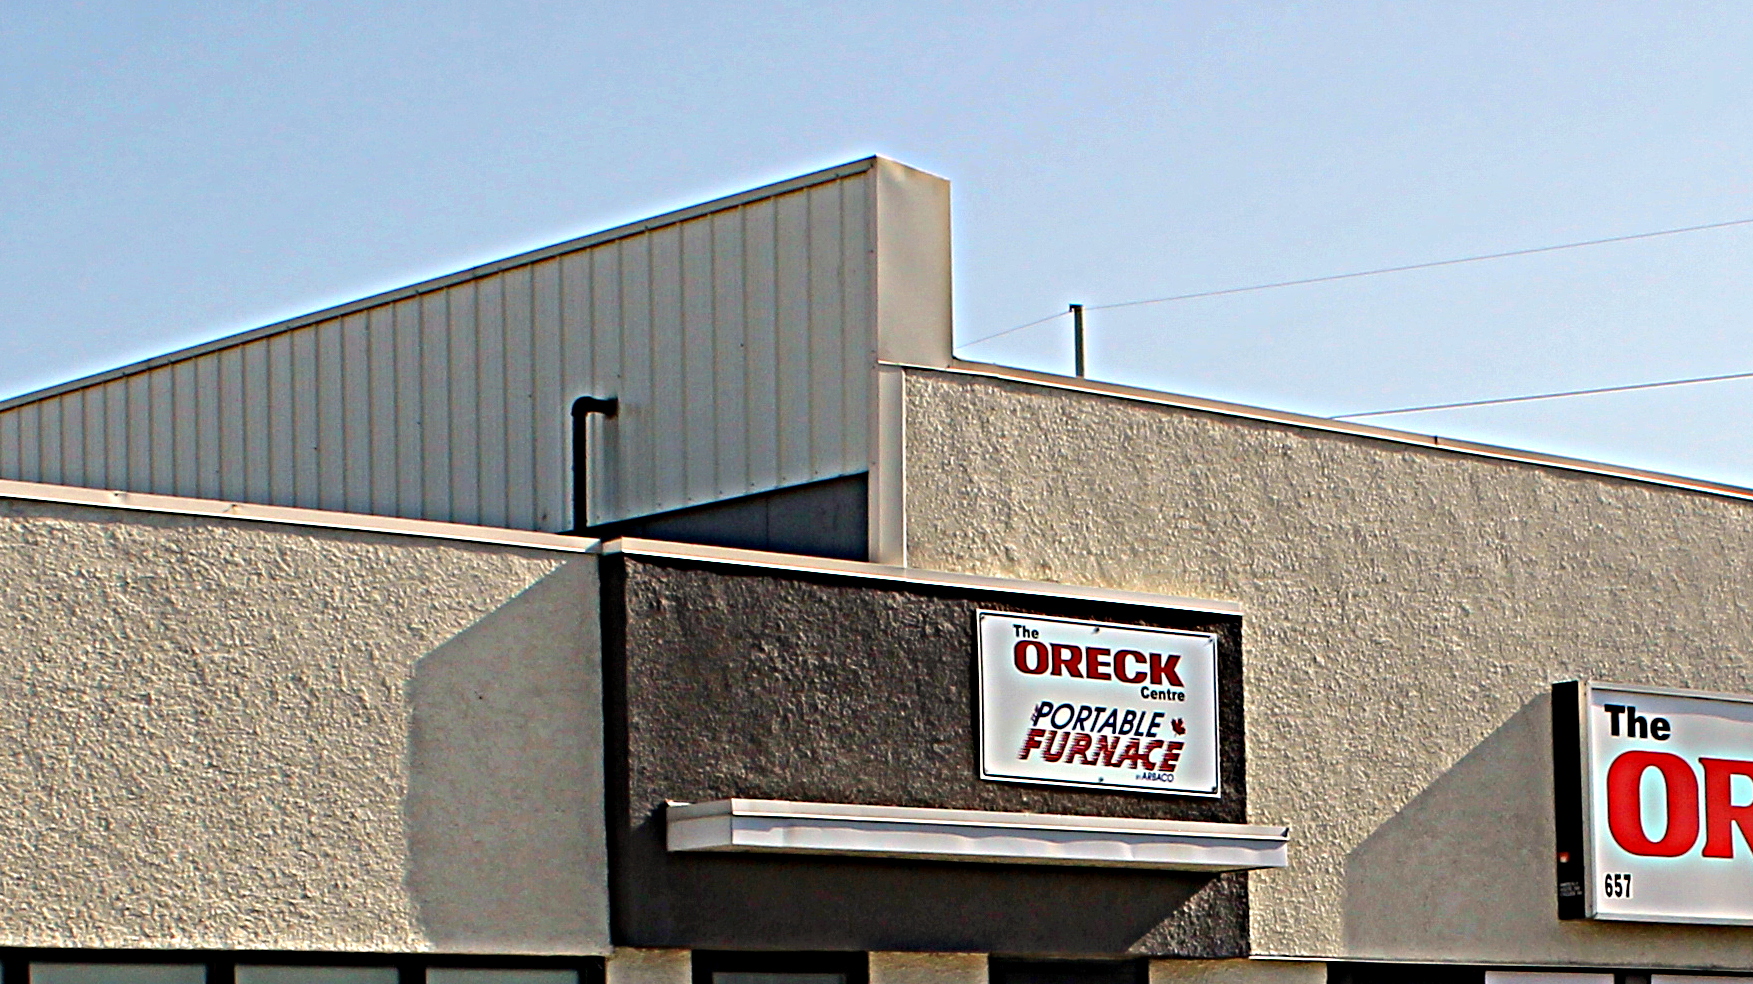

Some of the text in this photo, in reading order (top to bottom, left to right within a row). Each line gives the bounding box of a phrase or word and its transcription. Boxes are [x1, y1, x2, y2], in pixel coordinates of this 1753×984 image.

[1013, 624, 1039, 639] The
[1014, 639, 1184, 688] ORECK
[1141, 686, 1185, 701] Centre
[1032, 700, 1165, 738] PORTABLE
[1604, 704, 1671, 741] The
[1016, 728, 1185, 772] FURNACE
[1604, 873, 1631, 898] 657
